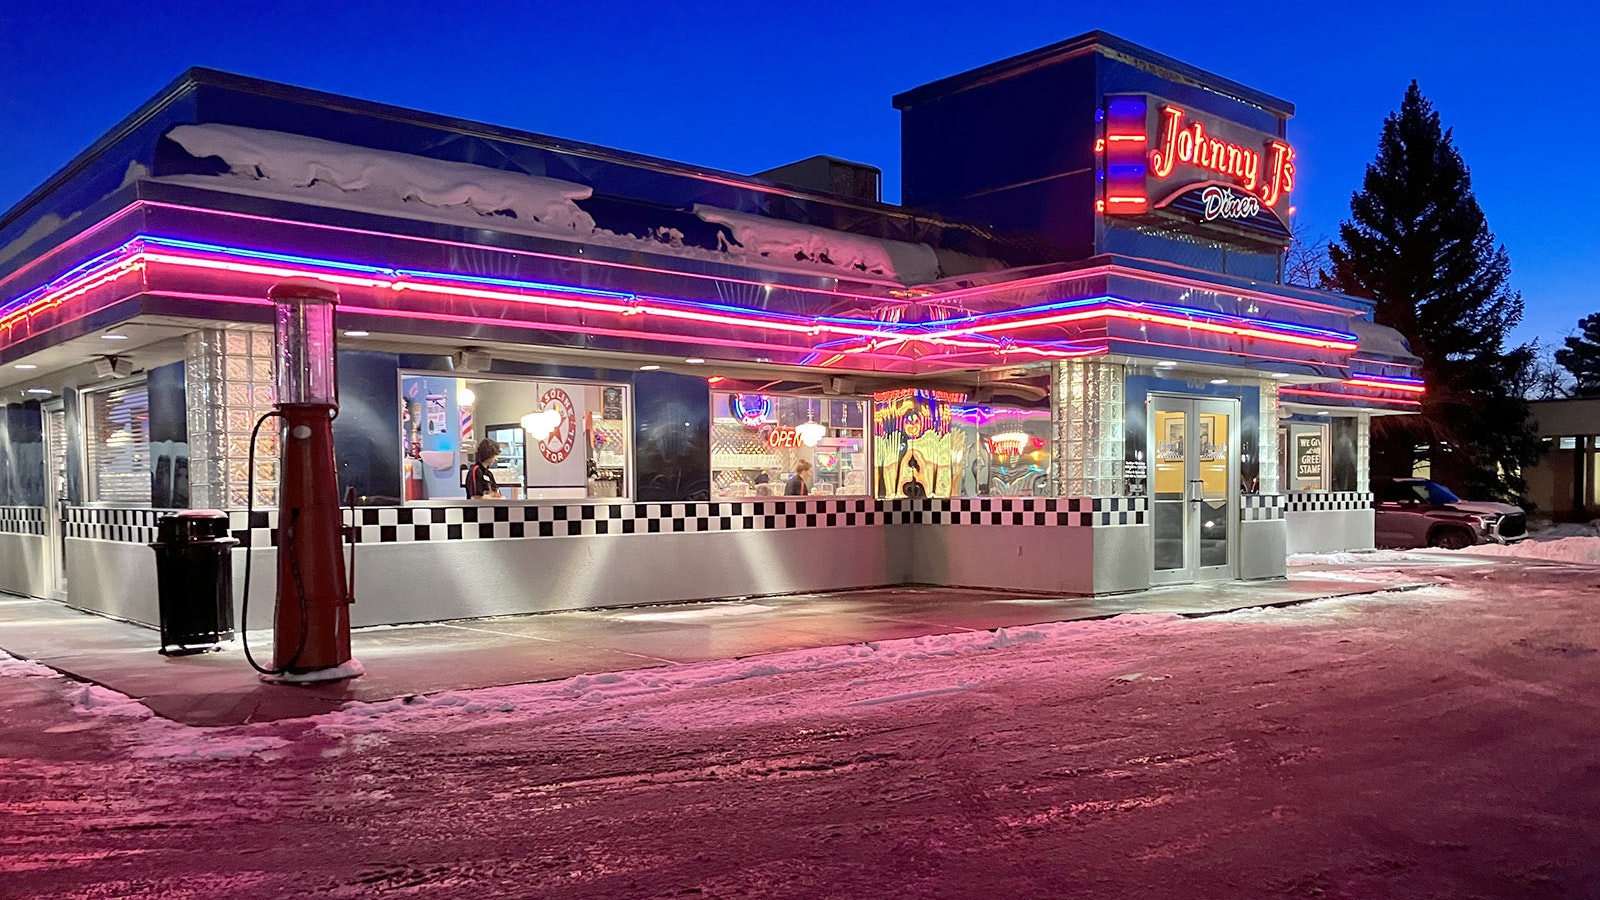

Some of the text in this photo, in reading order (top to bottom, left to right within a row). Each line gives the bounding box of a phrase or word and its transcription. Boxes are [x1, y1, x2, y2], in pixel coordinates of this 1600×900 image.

[1150, 105, 1296, 207] Johnny J's
[1202, 186, 1260, 220] Diner
[539, 389, 575, 417] ASOLINE
[539, 429, 575, 462] OTOR OIL
[769, 430, 803, 448] OPEN
[1300, 439, 1310, 447] WE
